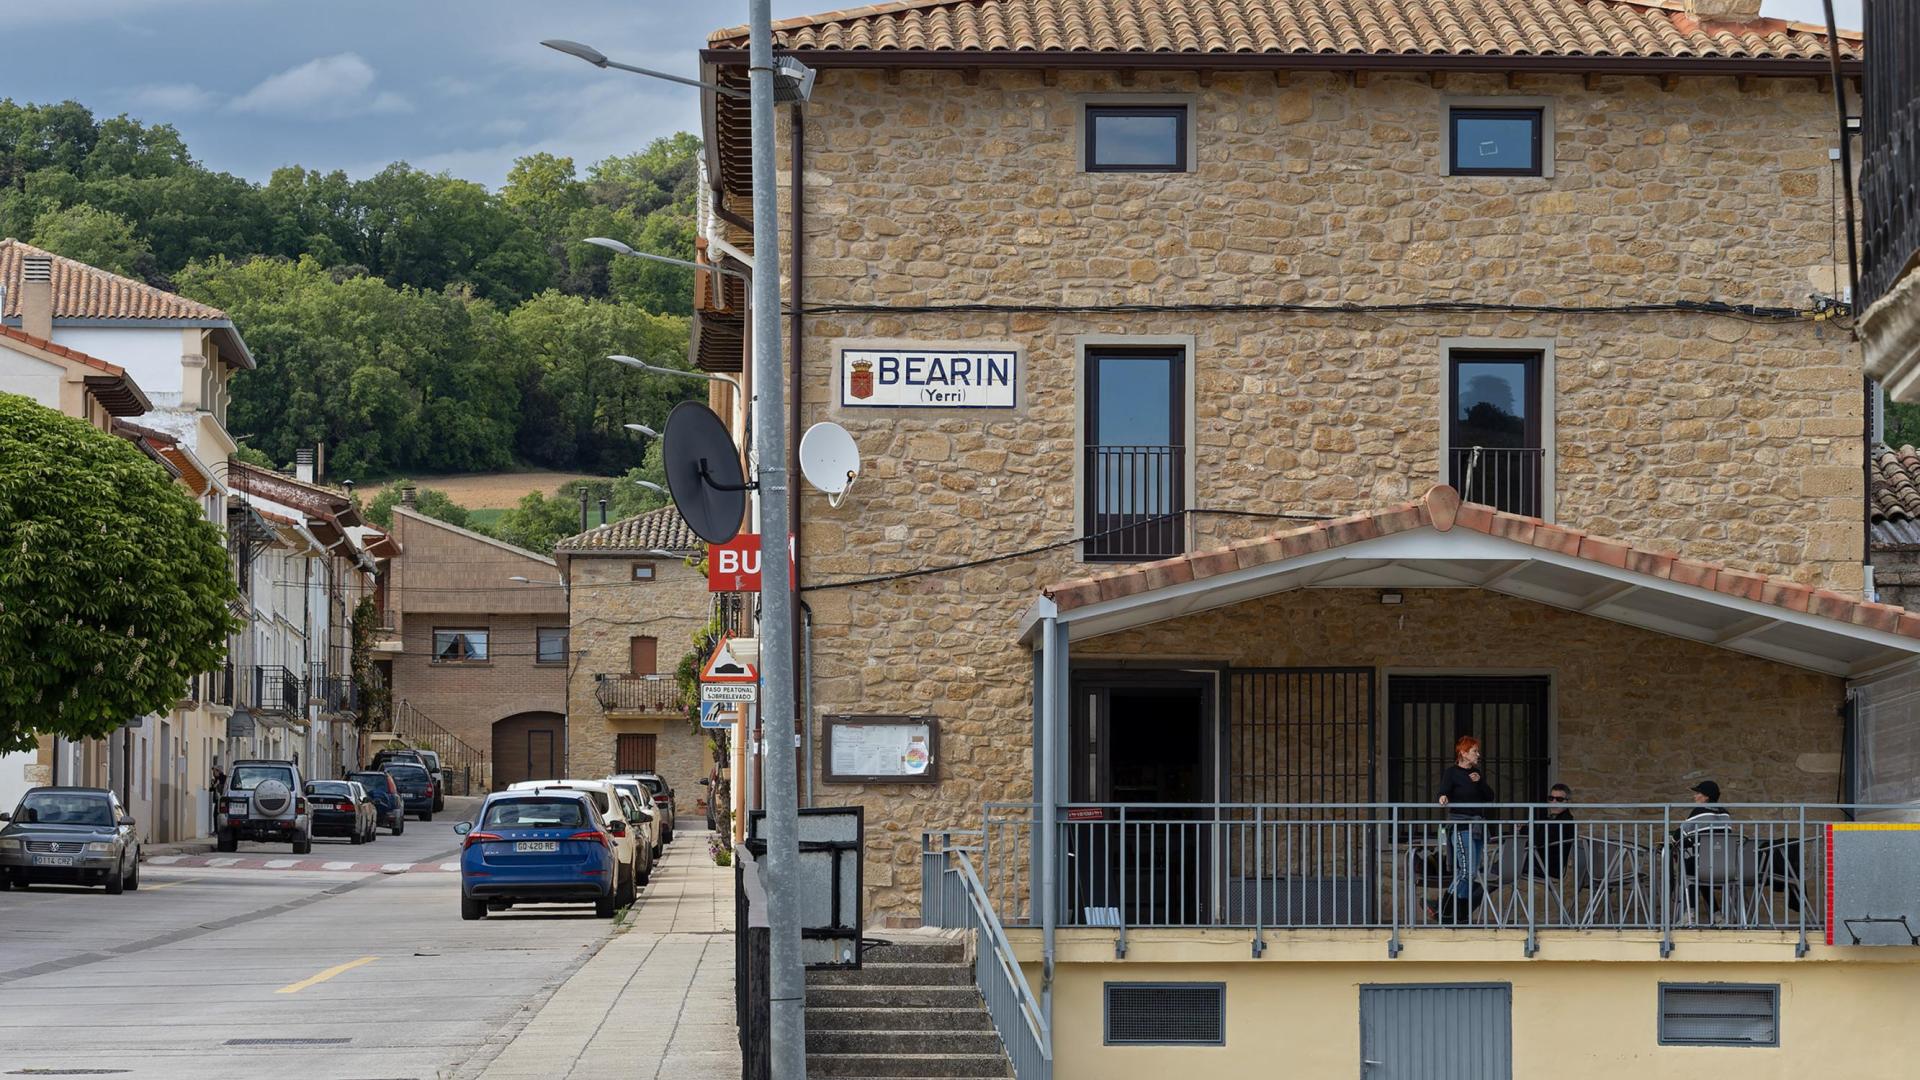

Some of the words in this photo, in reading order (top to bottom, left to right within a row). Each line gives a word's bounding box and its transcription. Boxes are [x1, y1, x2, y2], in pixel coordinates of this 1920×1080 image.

[879, 356, 1008, 386] BEARIN
[920, 388, 966, 402] (Yerri)
[719, 549, 761, 574] BU
